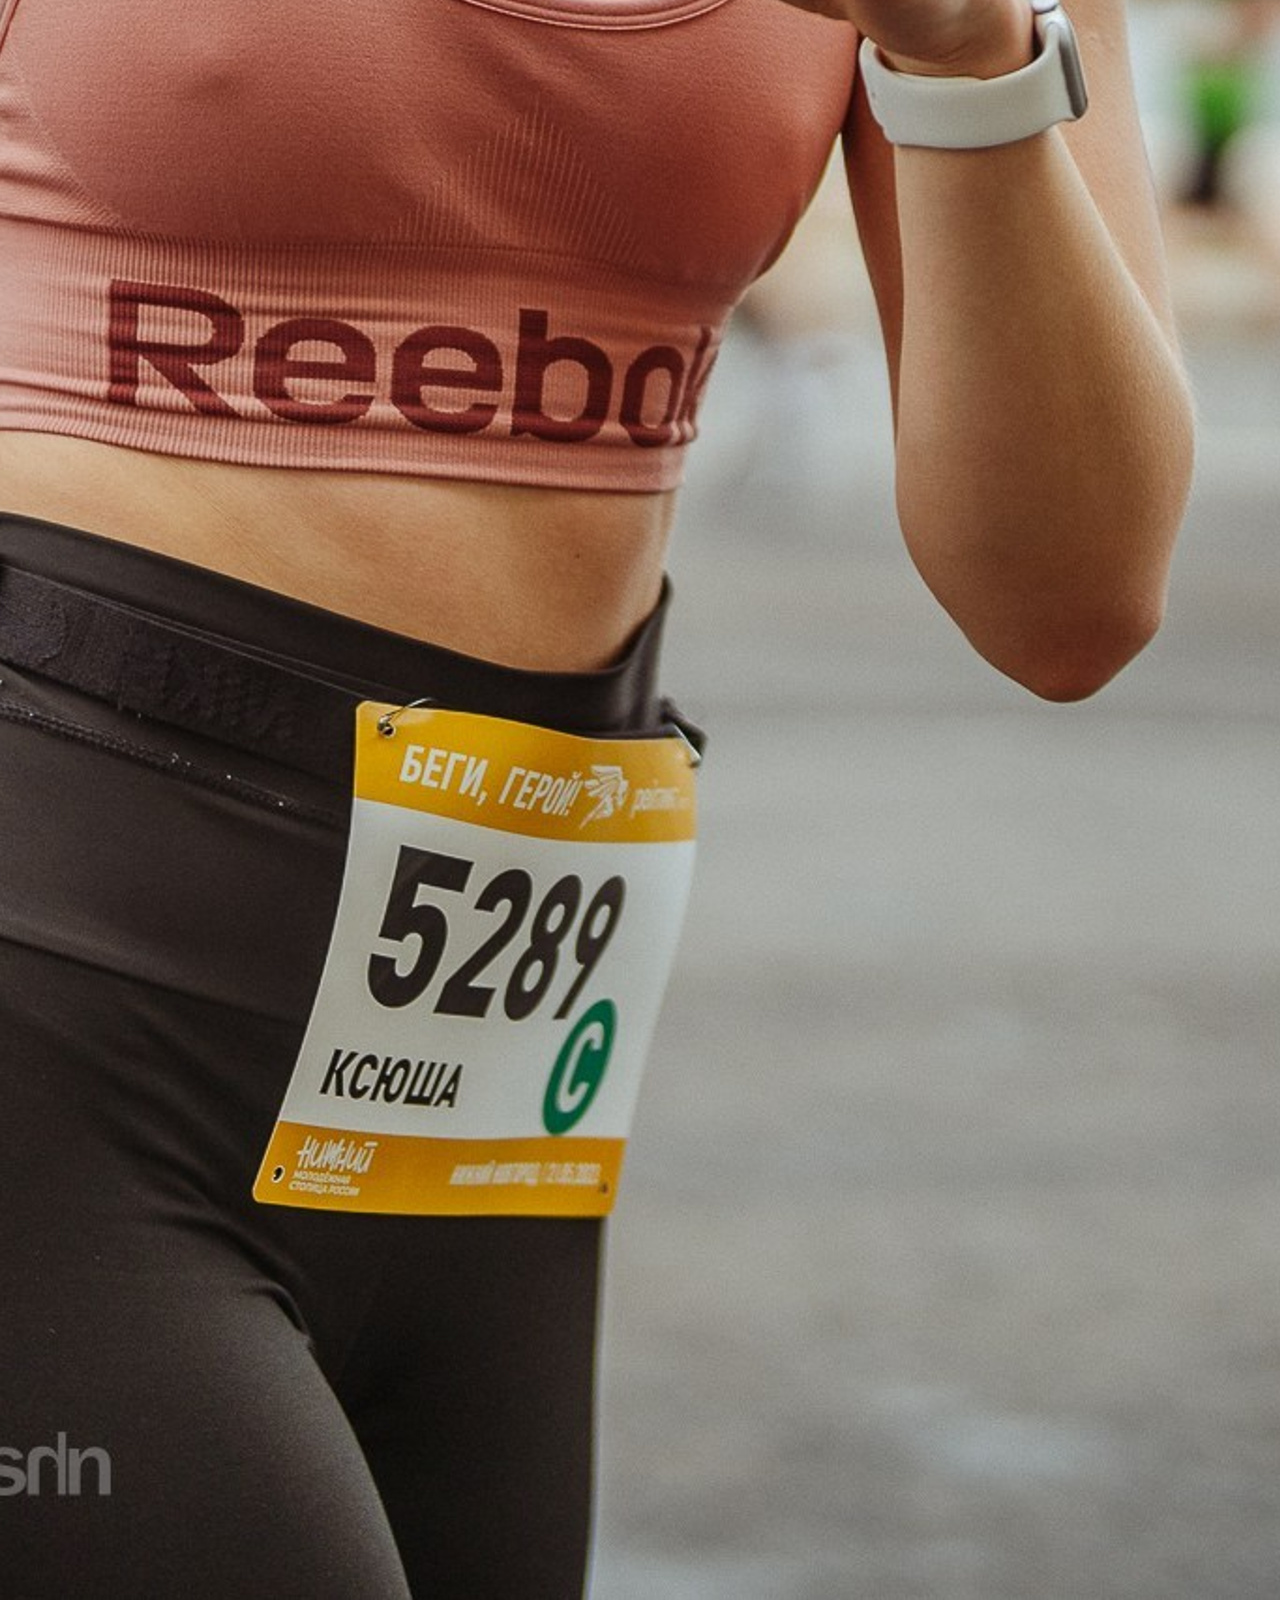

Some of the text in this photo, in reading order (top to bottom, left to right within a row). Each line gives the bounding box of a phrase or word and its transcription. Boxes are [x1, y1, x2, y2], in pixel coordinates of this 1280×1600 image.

[399, 744, 489, 806] БЕГИ,
[498, 766, 583, 816] ГЕРОЙ!
[367, 845, 626, 1021] 5289
[319, 1049, 463, 1108] КСЮША
